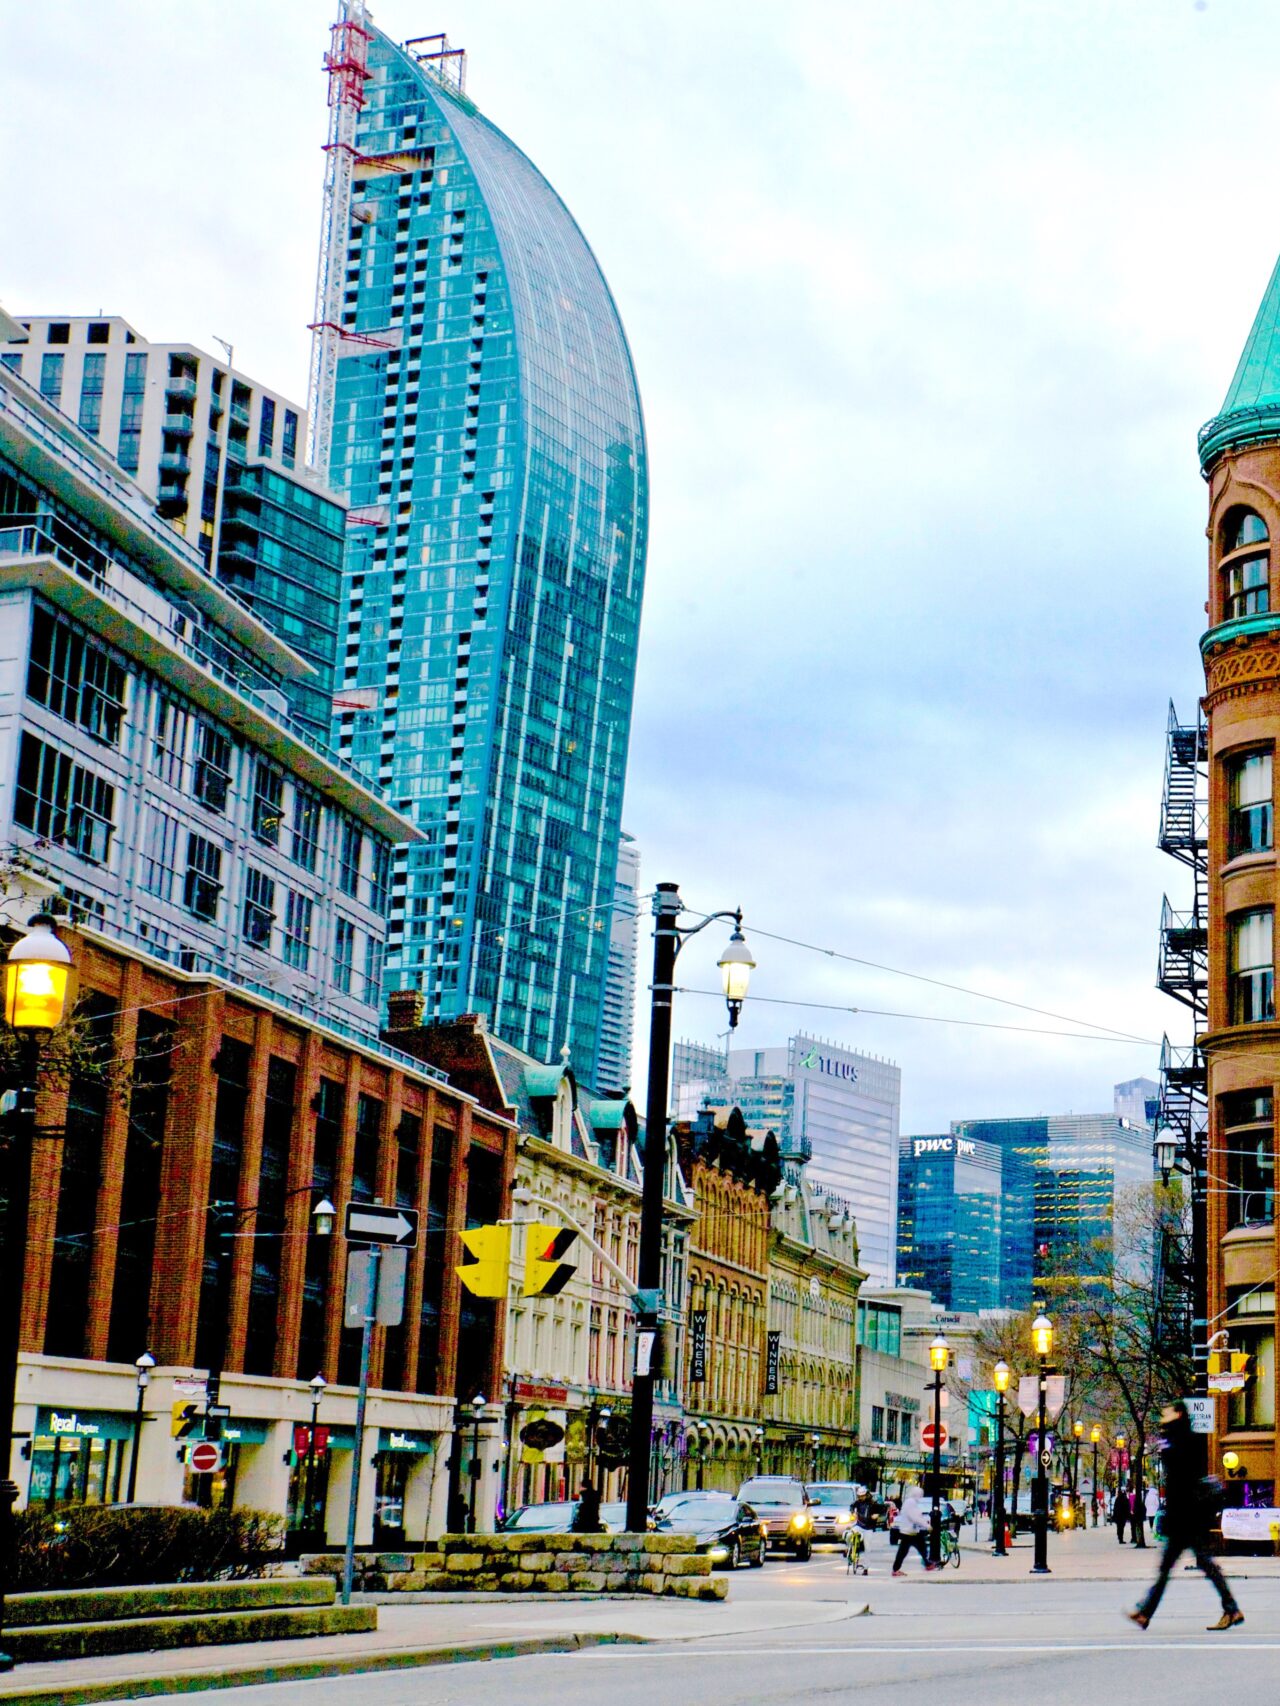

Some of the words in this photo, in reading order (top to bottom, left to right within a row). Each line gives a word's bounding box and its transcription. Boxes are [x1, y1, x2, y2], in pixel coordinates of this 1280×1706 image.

[914, 1138, 953, 1157] pwc
[956, 1139, 976, 1156] pwc
[694, 1315, 707, 1377] WINNERS
[768, 1335, 780, 1390] WINNERS
[1193, 1402, 1205, 1412] NO
[50, 1412, 77, 1434] Rexall
